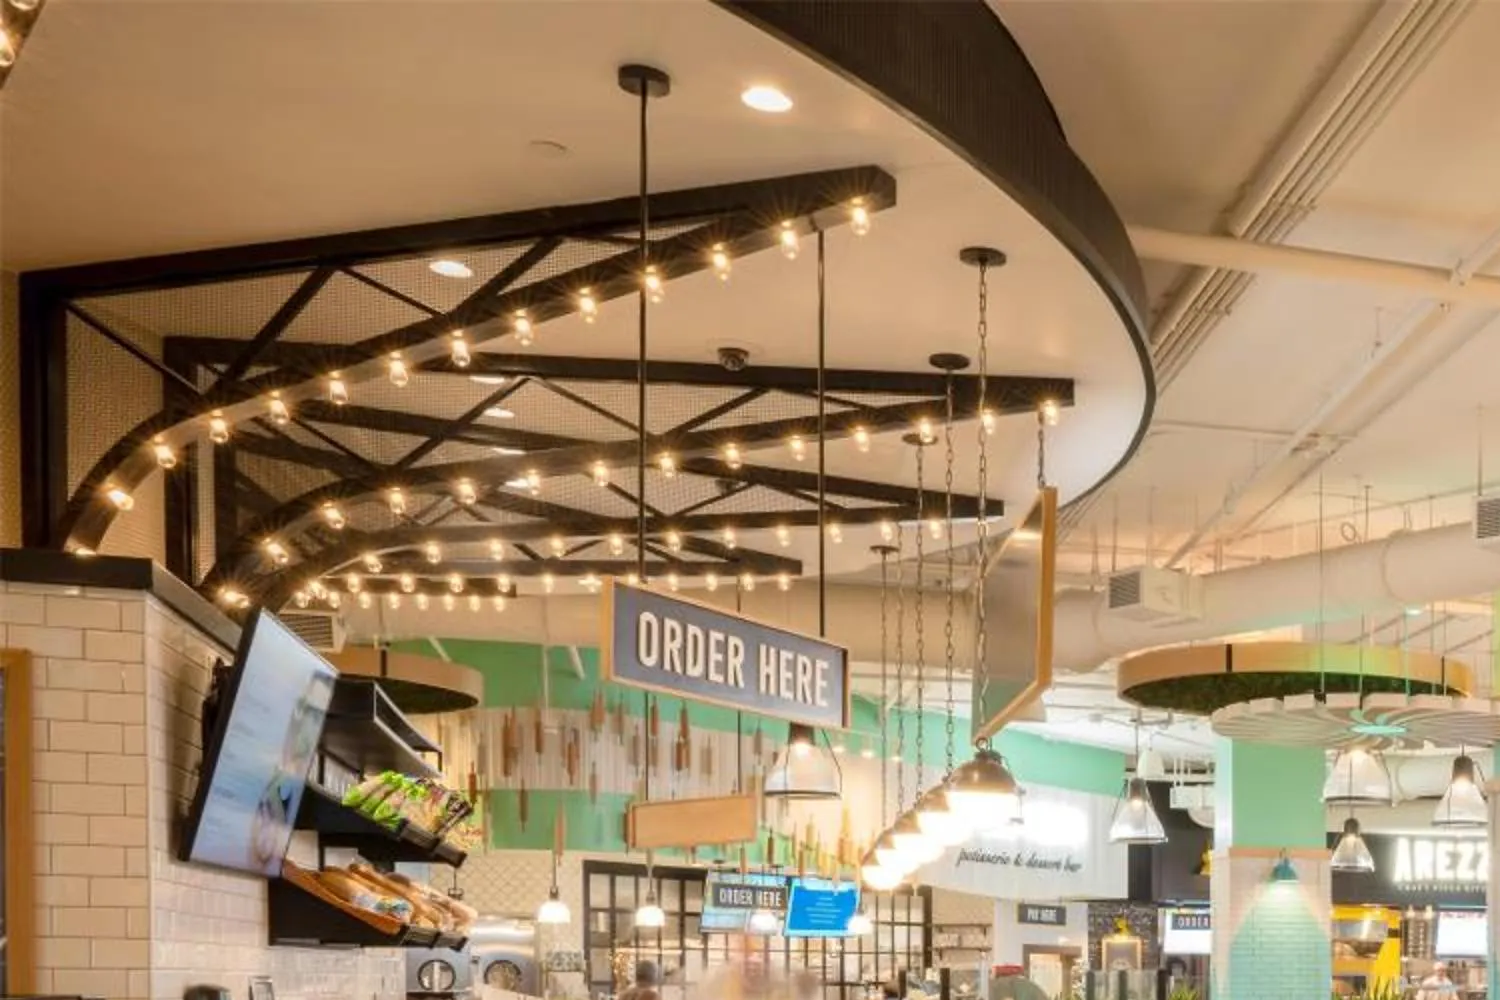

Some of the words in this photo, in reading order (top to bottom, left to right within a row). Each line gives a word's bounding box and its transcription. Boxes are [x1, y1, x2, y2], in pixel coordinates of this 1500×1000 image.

[637, 611, 745, 688] ORDER
[758, 643, 830, 707] HERE
[719, 888, 753, 905] ORDER
[757, 890, 782, 907] HERE
